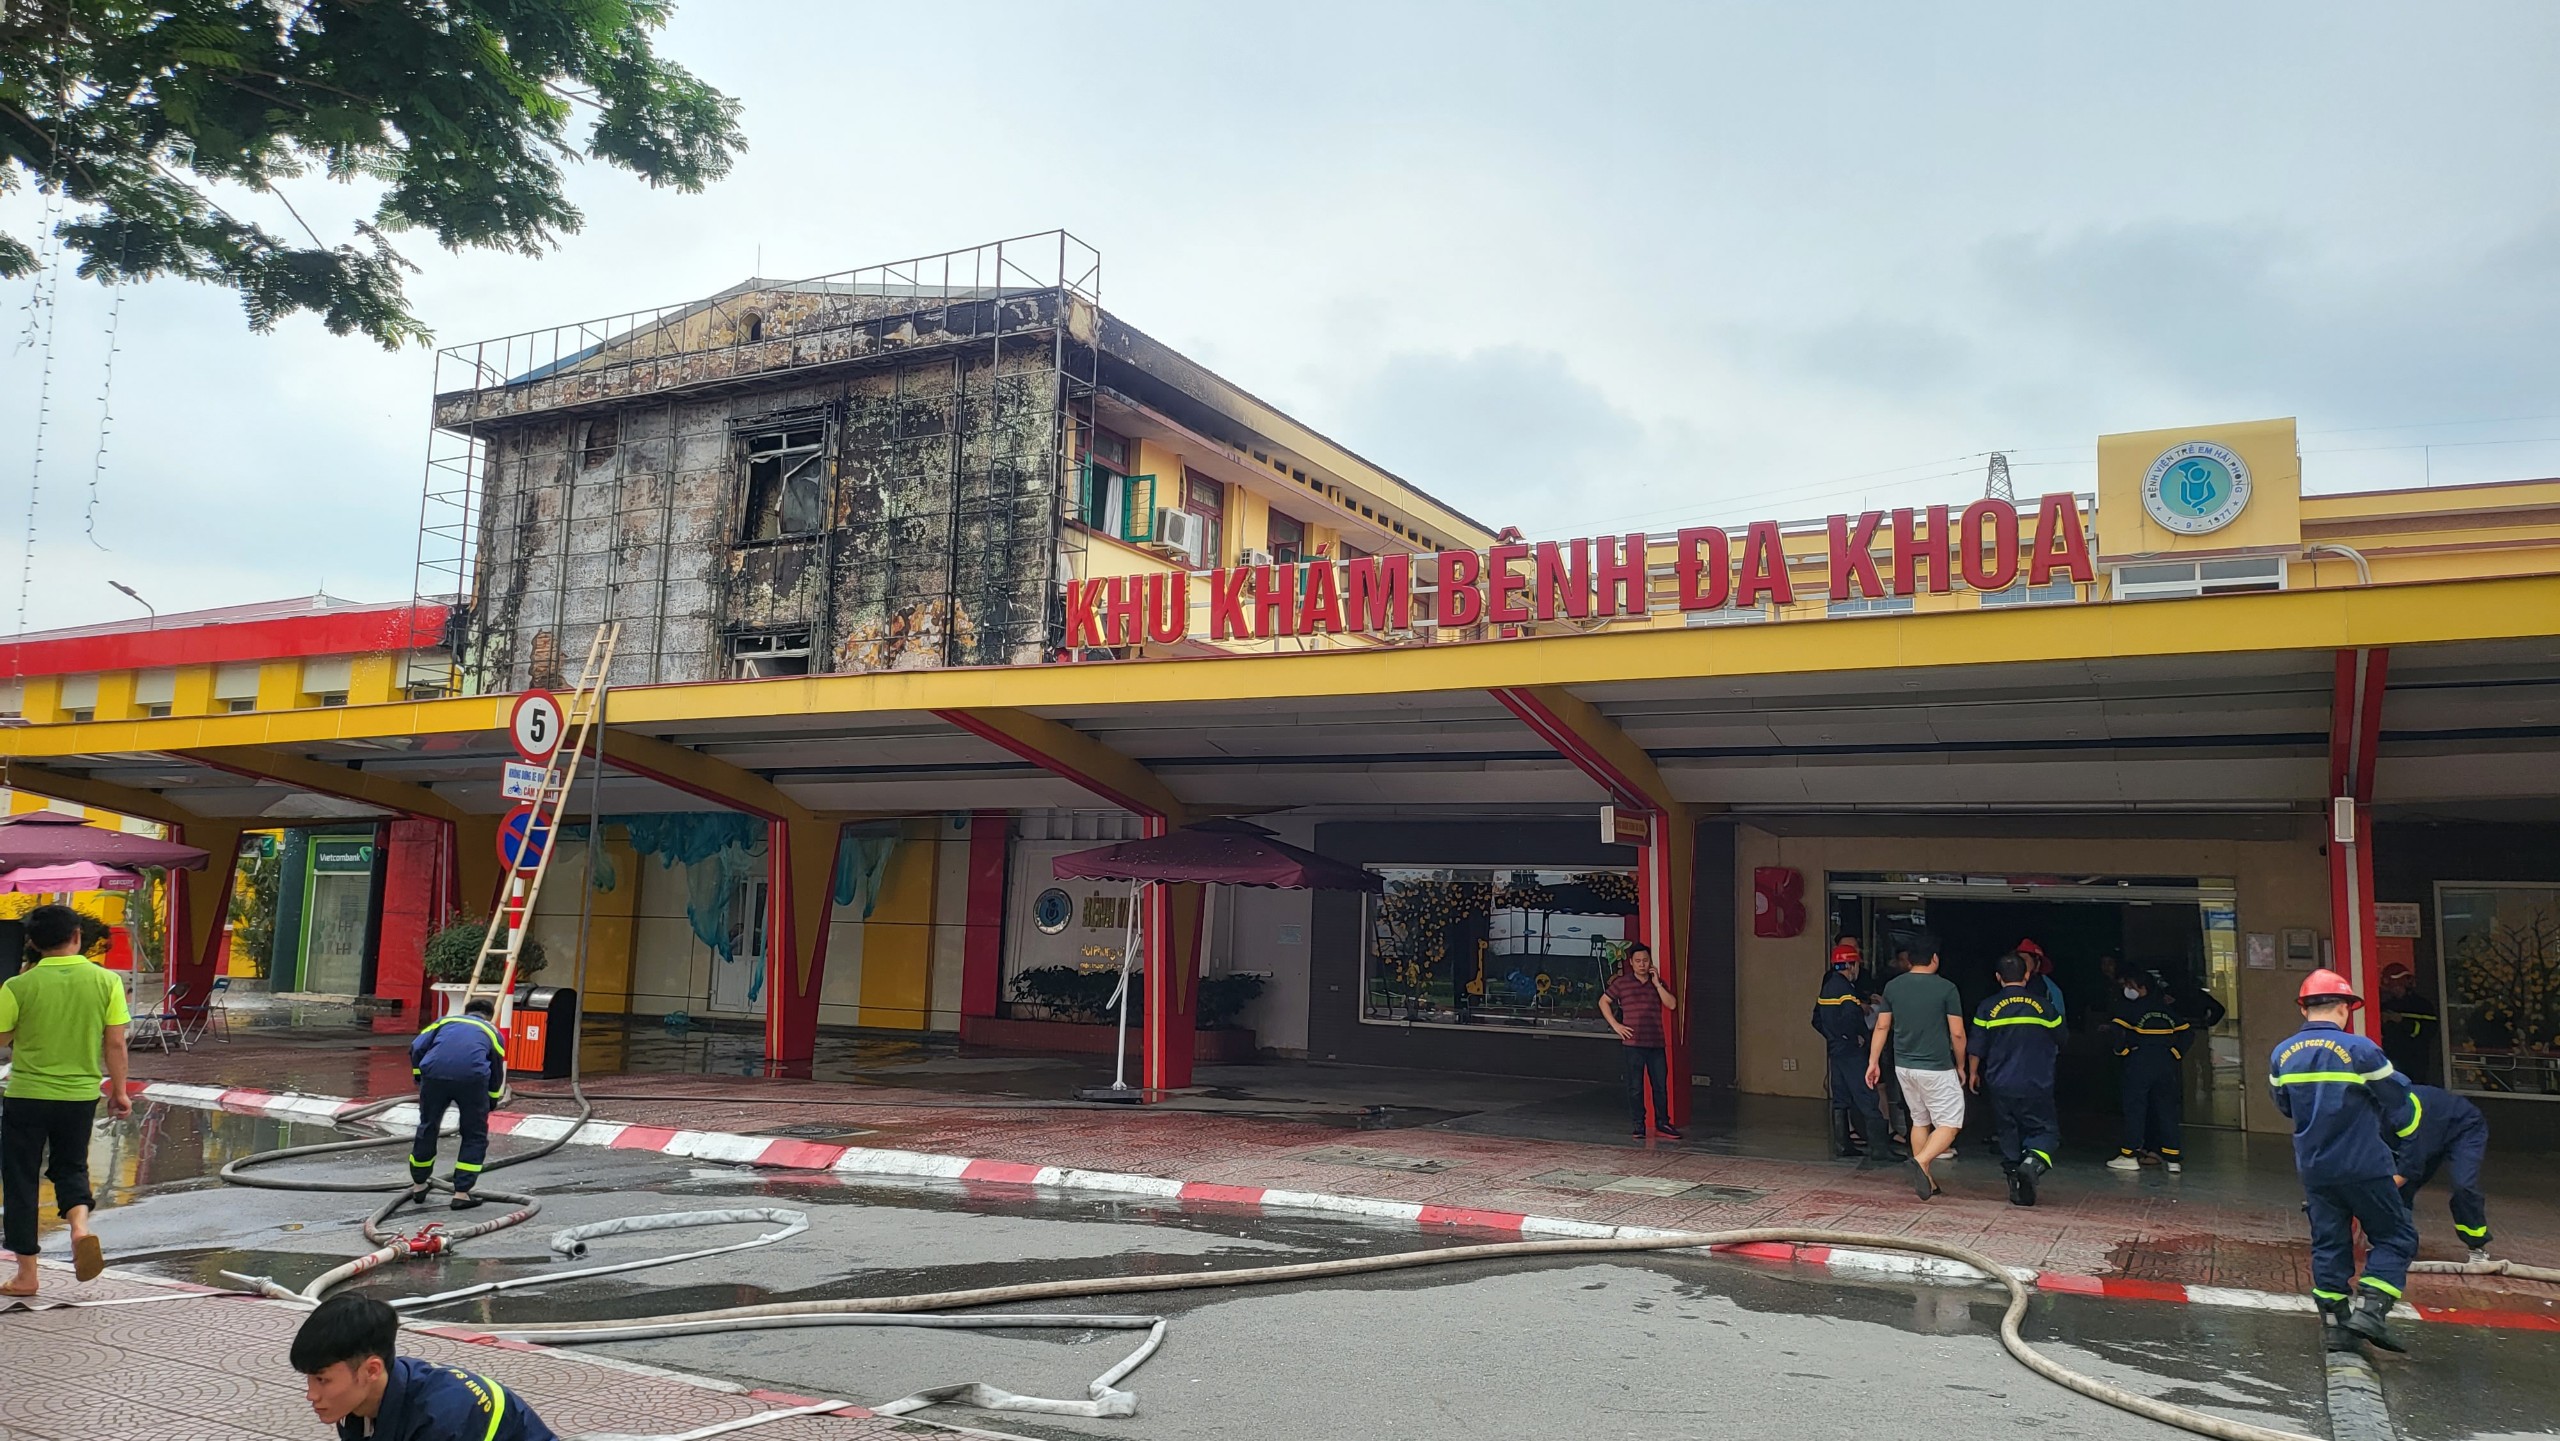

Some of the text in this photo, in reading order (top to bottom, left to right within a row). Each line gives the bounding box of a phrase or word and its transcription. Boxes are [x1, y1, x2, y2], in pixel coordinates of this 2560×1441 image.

[2148, 445, 2245, 498] BỆNH VIỆN TRẺ EM HẢI PHÒNG
[1066, 491, 2095, 649] KHU KHÁM BỆNH ĐA KHOA
[530, 708, 547, 743] 5
[320, 853, 360, 862] Vietcombank
[2290, 1041, 2304, 1053] SÁT
[2305, 1039, 2324, 1047] PCCC
[465, 1380, 492, 1413] CẢNH
